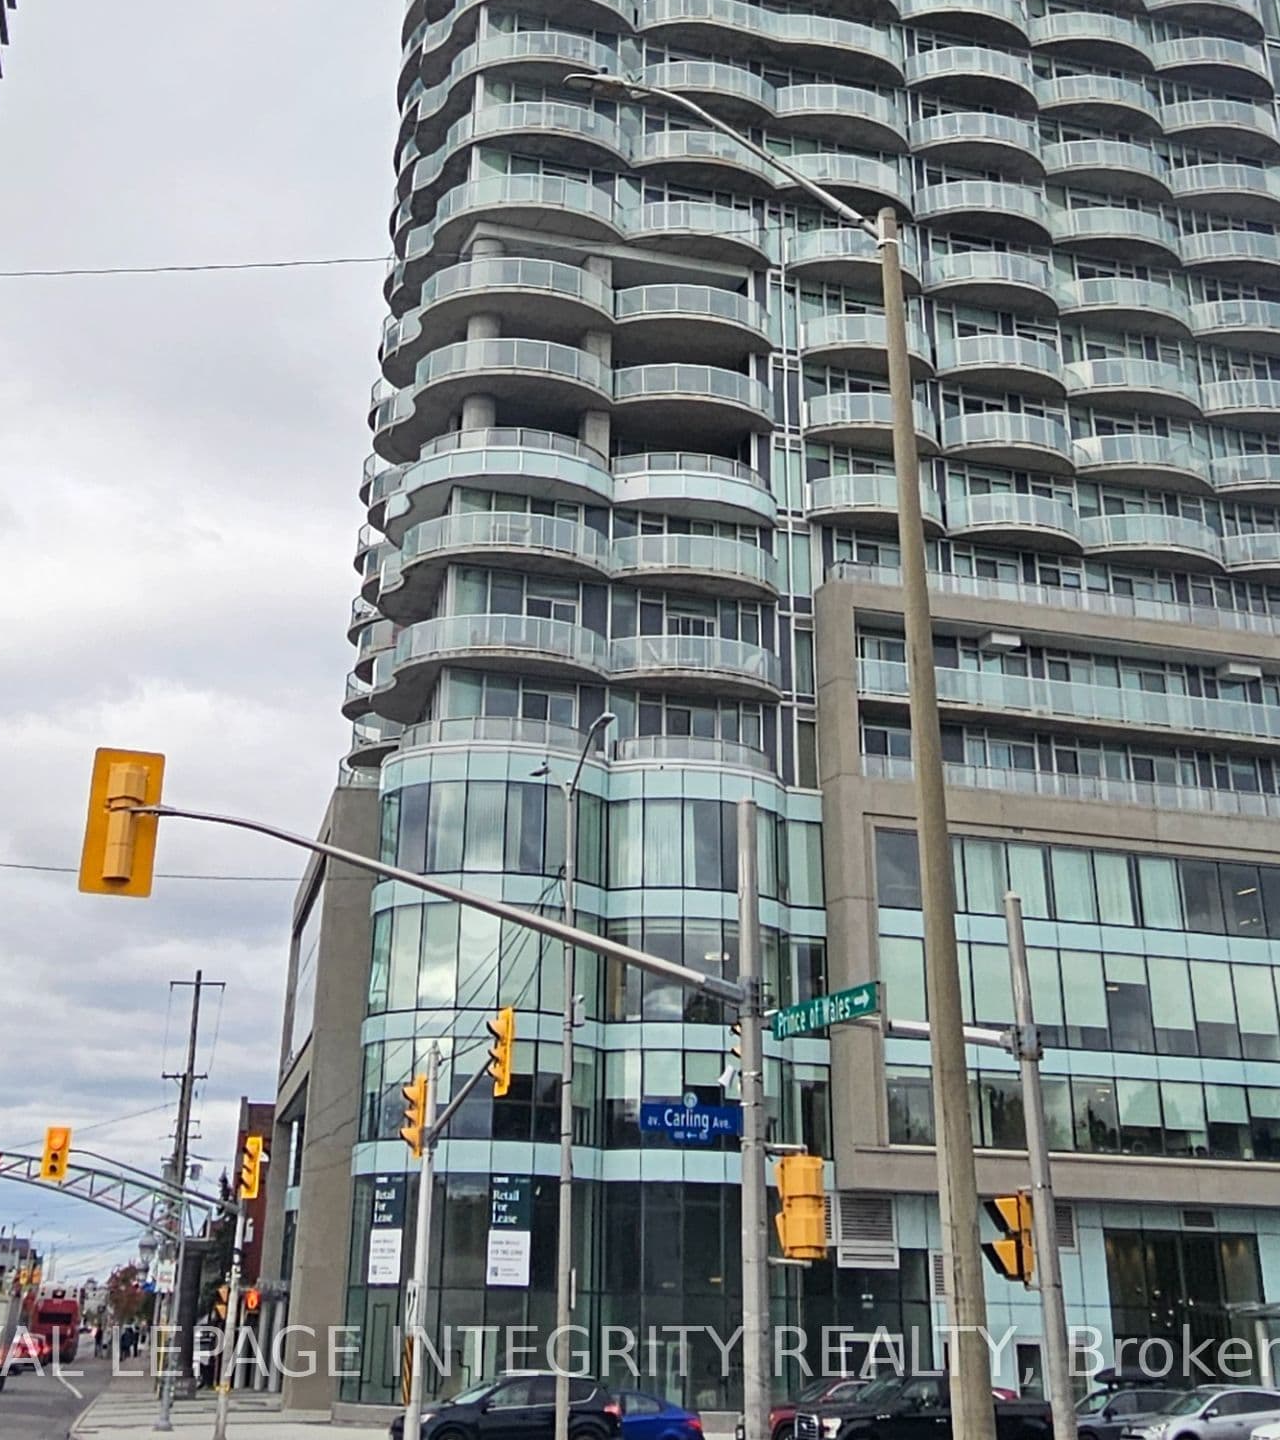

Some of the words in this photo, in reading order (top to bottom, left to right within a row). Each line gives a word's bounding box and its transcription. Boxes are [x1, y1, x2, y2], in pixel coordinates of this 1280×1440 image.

[777, 1009, 805, 1037] Prince
[809, 1000, 820, 1029] of
[647, 1115, 662, 1127] av.
[664, 1108, 710, 1134] Carling
[712, 1116, 733, 1129] Ave.
[492, 1189, 520, 1201] Retail
[492, 1201, 508, 1212] For
[491, 1212, 518, 1224] Lease
